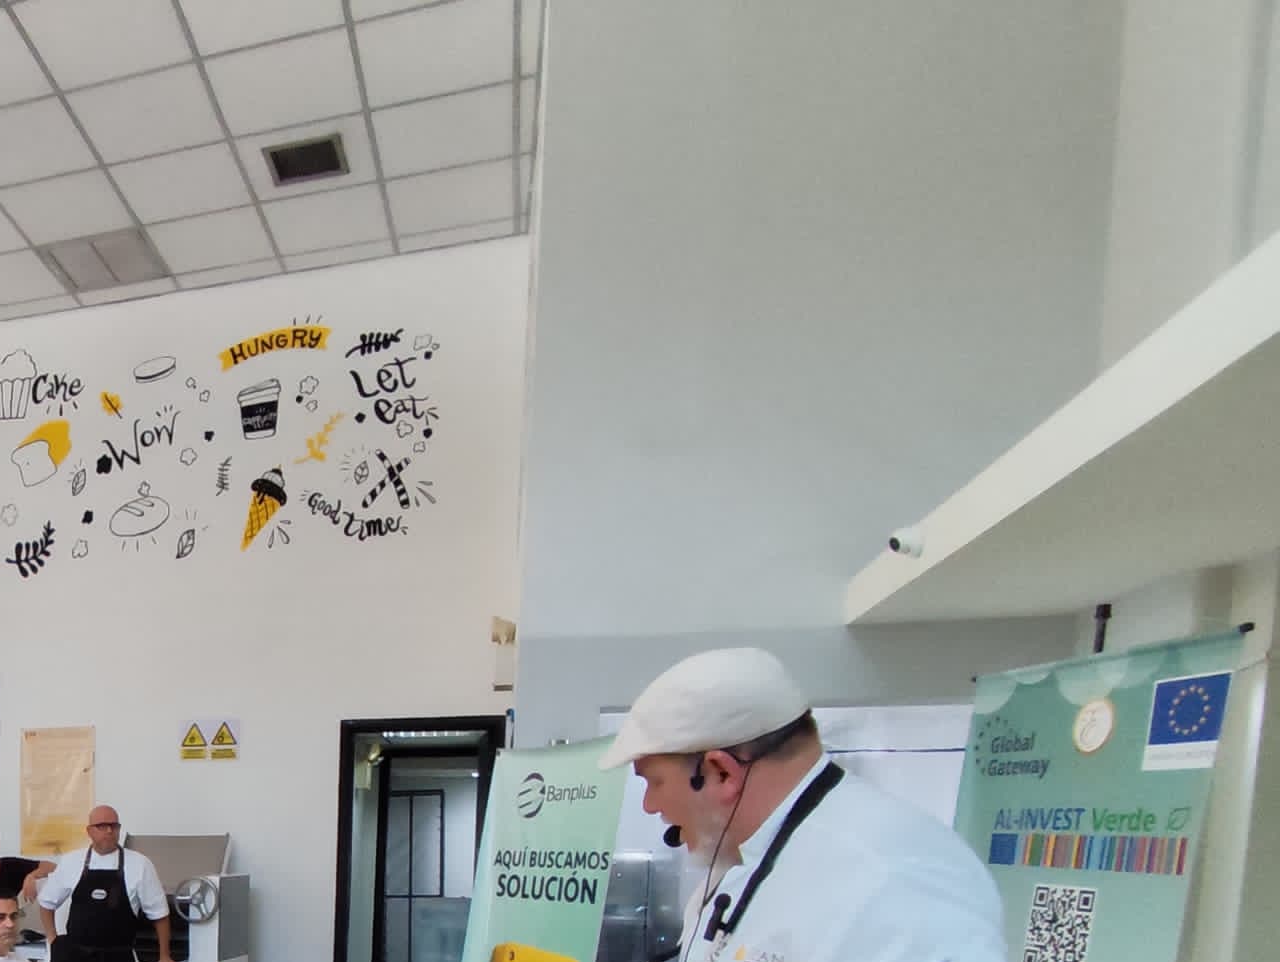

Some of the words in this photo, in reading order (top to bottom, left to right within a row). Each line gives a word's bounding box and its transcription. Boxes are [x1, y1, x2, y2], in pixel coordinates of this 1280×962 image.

[229, 326, 323, 366] HUNGRY
[350, 356, 418, 398] Let
[373, 396, 429, 425] eat
[991, 732, 1036, 754] Global
[987, 757, 1050, 779] Gateway
[546, 783, 597, 802] Banplus
[994, 808, 1085, 831] AL-INVEST
[1091, 808, 1156, 832] Verde
[494, 846, 528, 867] AQUÍ
[529, 850, 609, 870] BUSCAMOS
[496, 871, 598, 904] SOLUCIÓN
